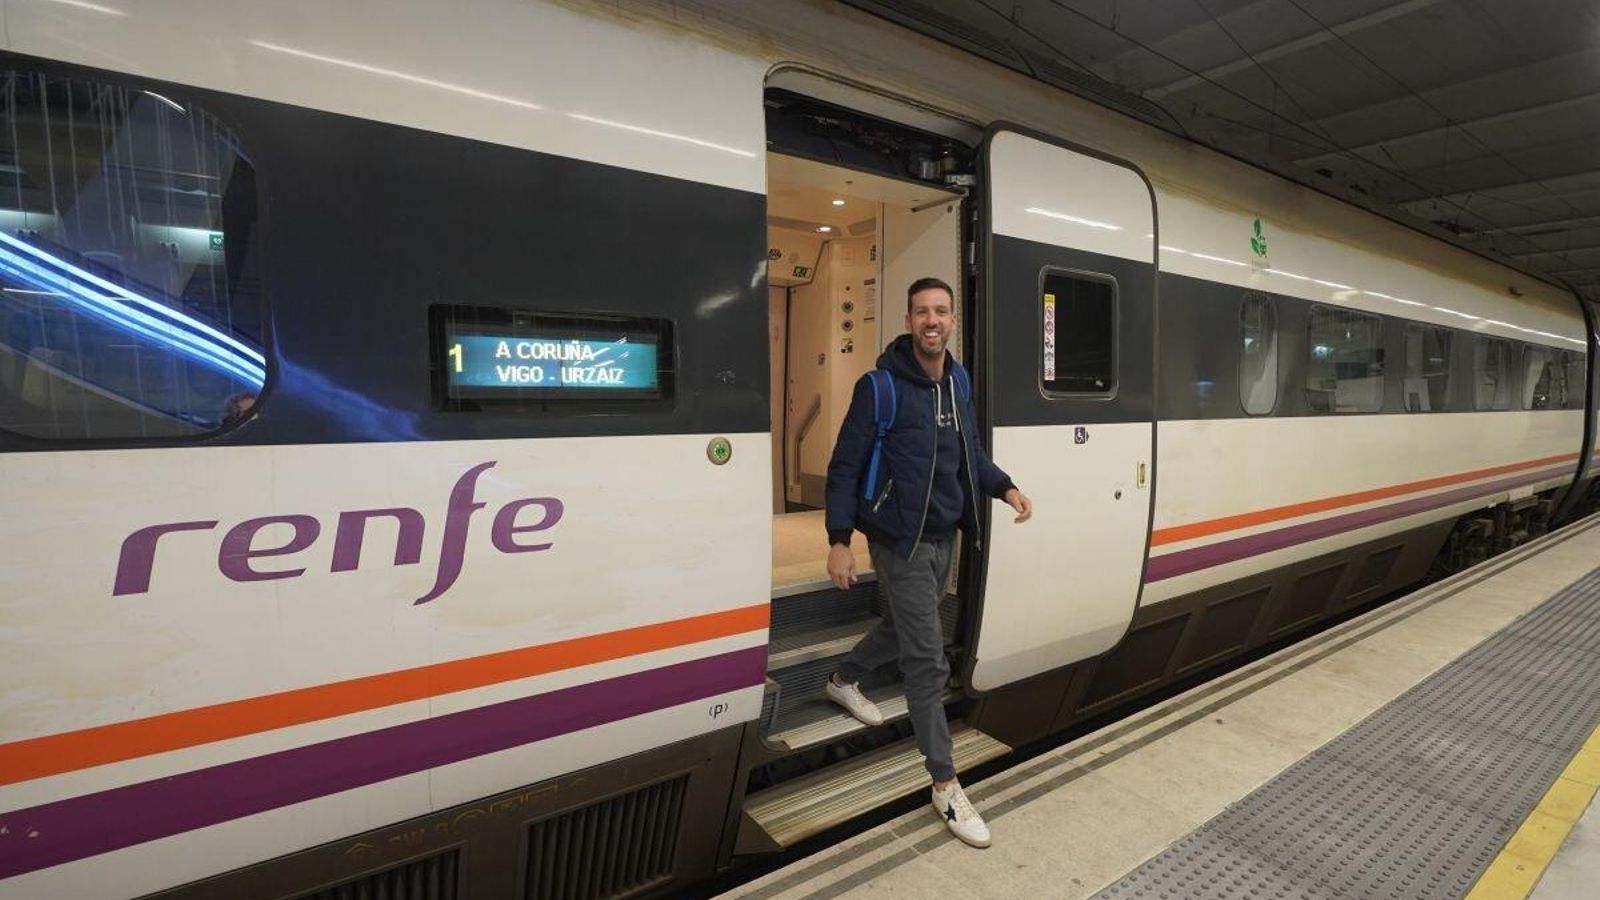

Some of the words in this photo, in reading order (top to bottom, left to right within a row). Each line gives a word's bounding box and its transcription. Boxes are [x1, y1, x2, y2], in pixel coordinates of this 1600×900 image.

[449, 344, 463, 373] 1
[495, 341, 511, 358] A
[517, 340, 595, 361] CORUÑA
[496, 366, 543, 383] VIGO
[561, 367, 625, 384] URZAIZ
[112, 460, 564, 606] renfe
